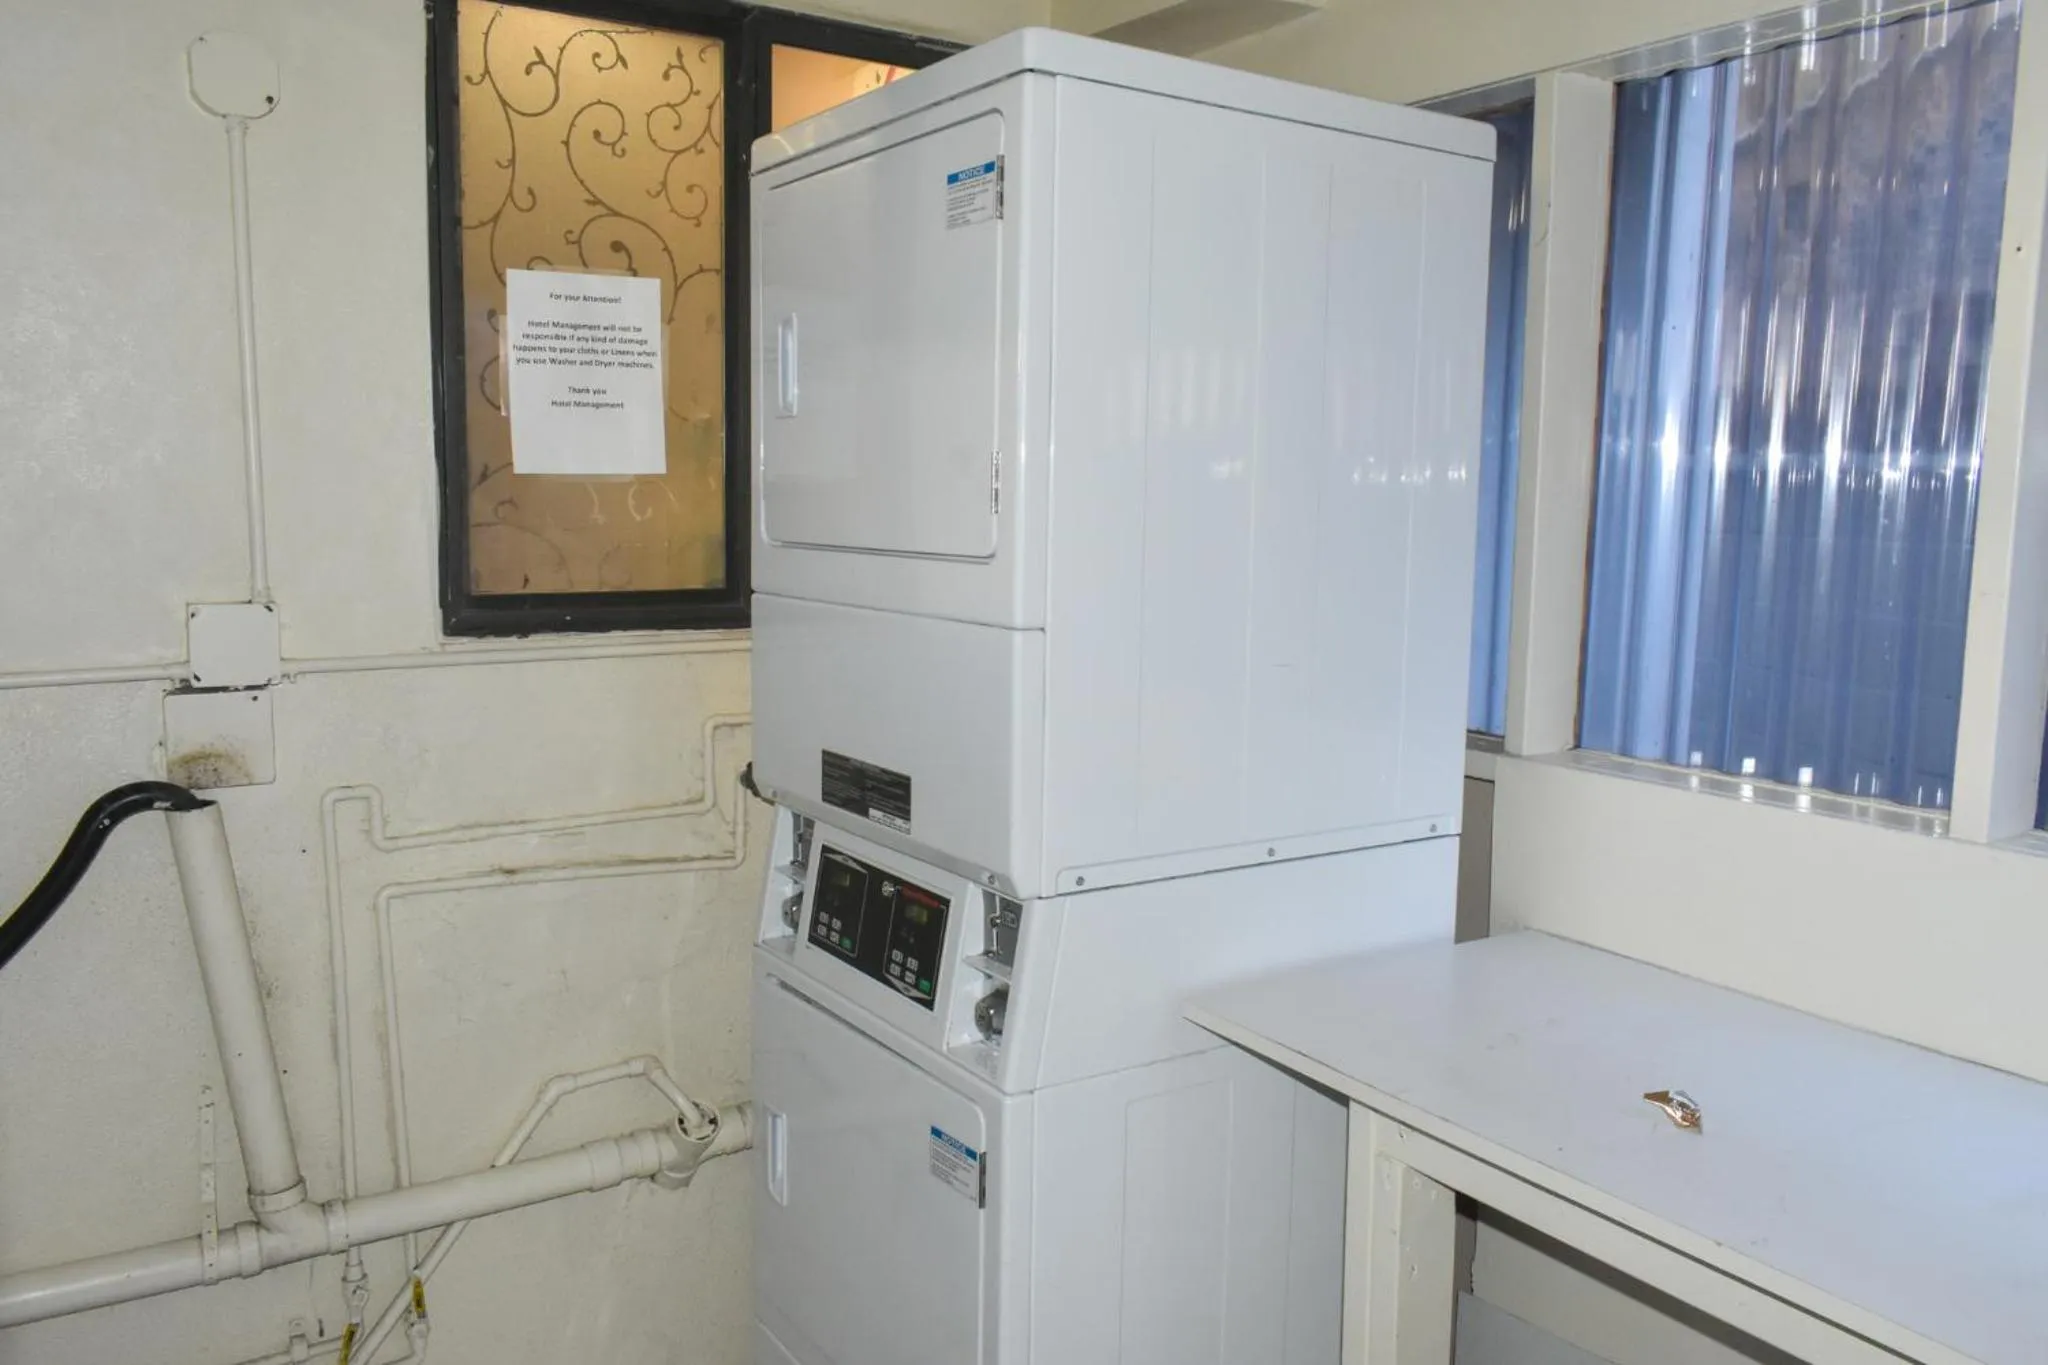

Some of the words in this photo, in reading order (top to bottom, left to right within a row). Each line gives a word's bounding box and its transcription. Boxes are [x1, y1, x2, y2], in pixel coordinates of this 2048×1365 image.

[958, 164, 984, 180] NOTICE
[549, 292, 562, 300] For
[564, 294, 581, 302] your
[582, 294, 622, 304] Attention!
[527, 320, 549, 328] Hotel
[552, 320, 601, 331] Management
[603, 324, 616, 332] will
[522, 333, 567, 341] responsible
[618, 336, 648, 346] damage
[513, 344, 547, 353] happens
[577, 346, 599, 355] cloths
[611, 348, 635, 356] Linens
[636, 349, 658, 357] when
[548, 357, 577, 365] Washer
[594, 360, 615, 368] Dryer
[568, 386, 591, 394] Thank
[592, 388, 607, 396] you
[551, 399, 572, 407] Hotel
[573, 400, 624, 409] Management
